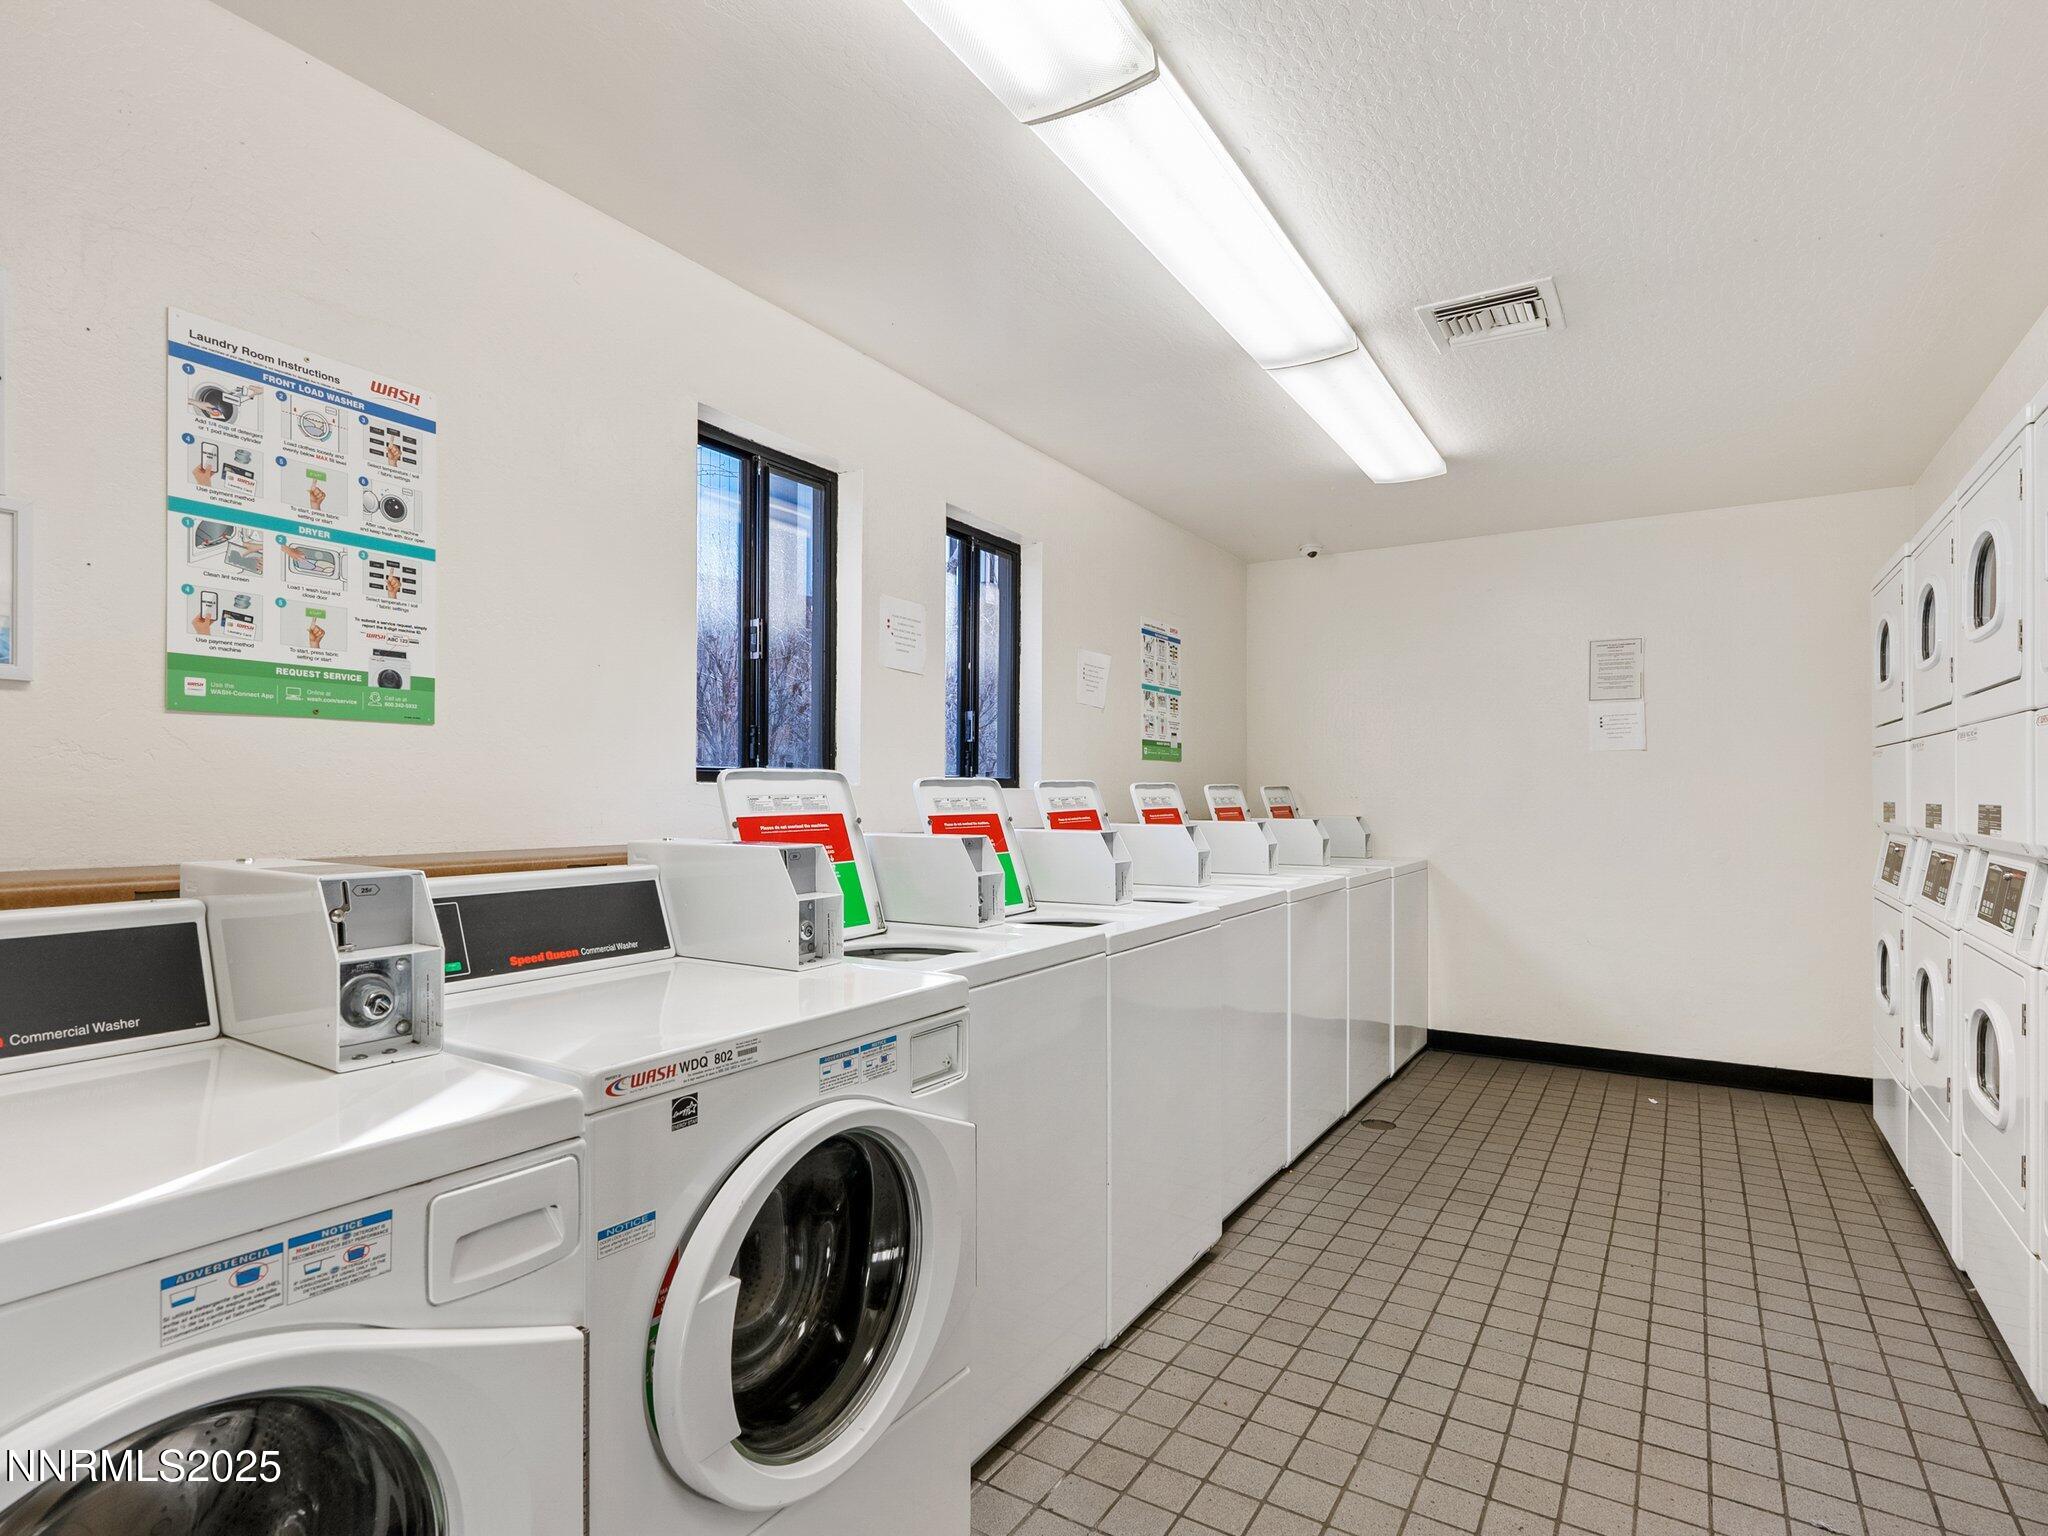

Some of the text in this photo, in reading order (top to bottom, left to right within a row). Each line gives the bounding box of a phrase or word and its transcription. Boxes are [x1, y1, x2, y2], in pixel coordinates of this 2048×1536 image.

[189, 329, 238, 353] Laundry
[242, 347, 274, 363] Room
[278, 358, 340, 384] Instructions
[263, 374, 364, 410] FRONT LOAD WASHER
[371, 380, 420, 405] WASH
[238, 429, 263, 439] detergent
[298, 444, 315, 452] clothes
[317, 448, 333, 457] loosely
[209, 489, 233, 498] payment
[234, 494, 255, 502] method
[218, 497, 242, 505] machine
[298, 526, 330, 538] DRYER
[381, 599, 407, 607] temperature
[276, 668, 362, 682] REQUEST SERVICE
[211, 689, 260, 698] WASH-Connect
[509, 940, 638, 967] Speed Queen Commercial Washer
[9, 1017, 140, 1045] Commercial Washer
[631, 1064, 676, 1088] WASH
[680, 1057, 708, 1073] WDQ
[714, 1050, 733, 1064] 802
[321, 1220, 363, 1237] NOTICE
[353, 1226, 380, 1237] DETERGENT
[606, 1216, 648, 1236] NOTICE
[355, 1229, 388, 1241] PERFORMANCE
[176, 1249, 270, 1285] ADVERTENCIA
[195, 1297, 230, 1311] detergente
[233, 1292, 245, 1300] que
[247, 1292, 281, 1307] detergente
